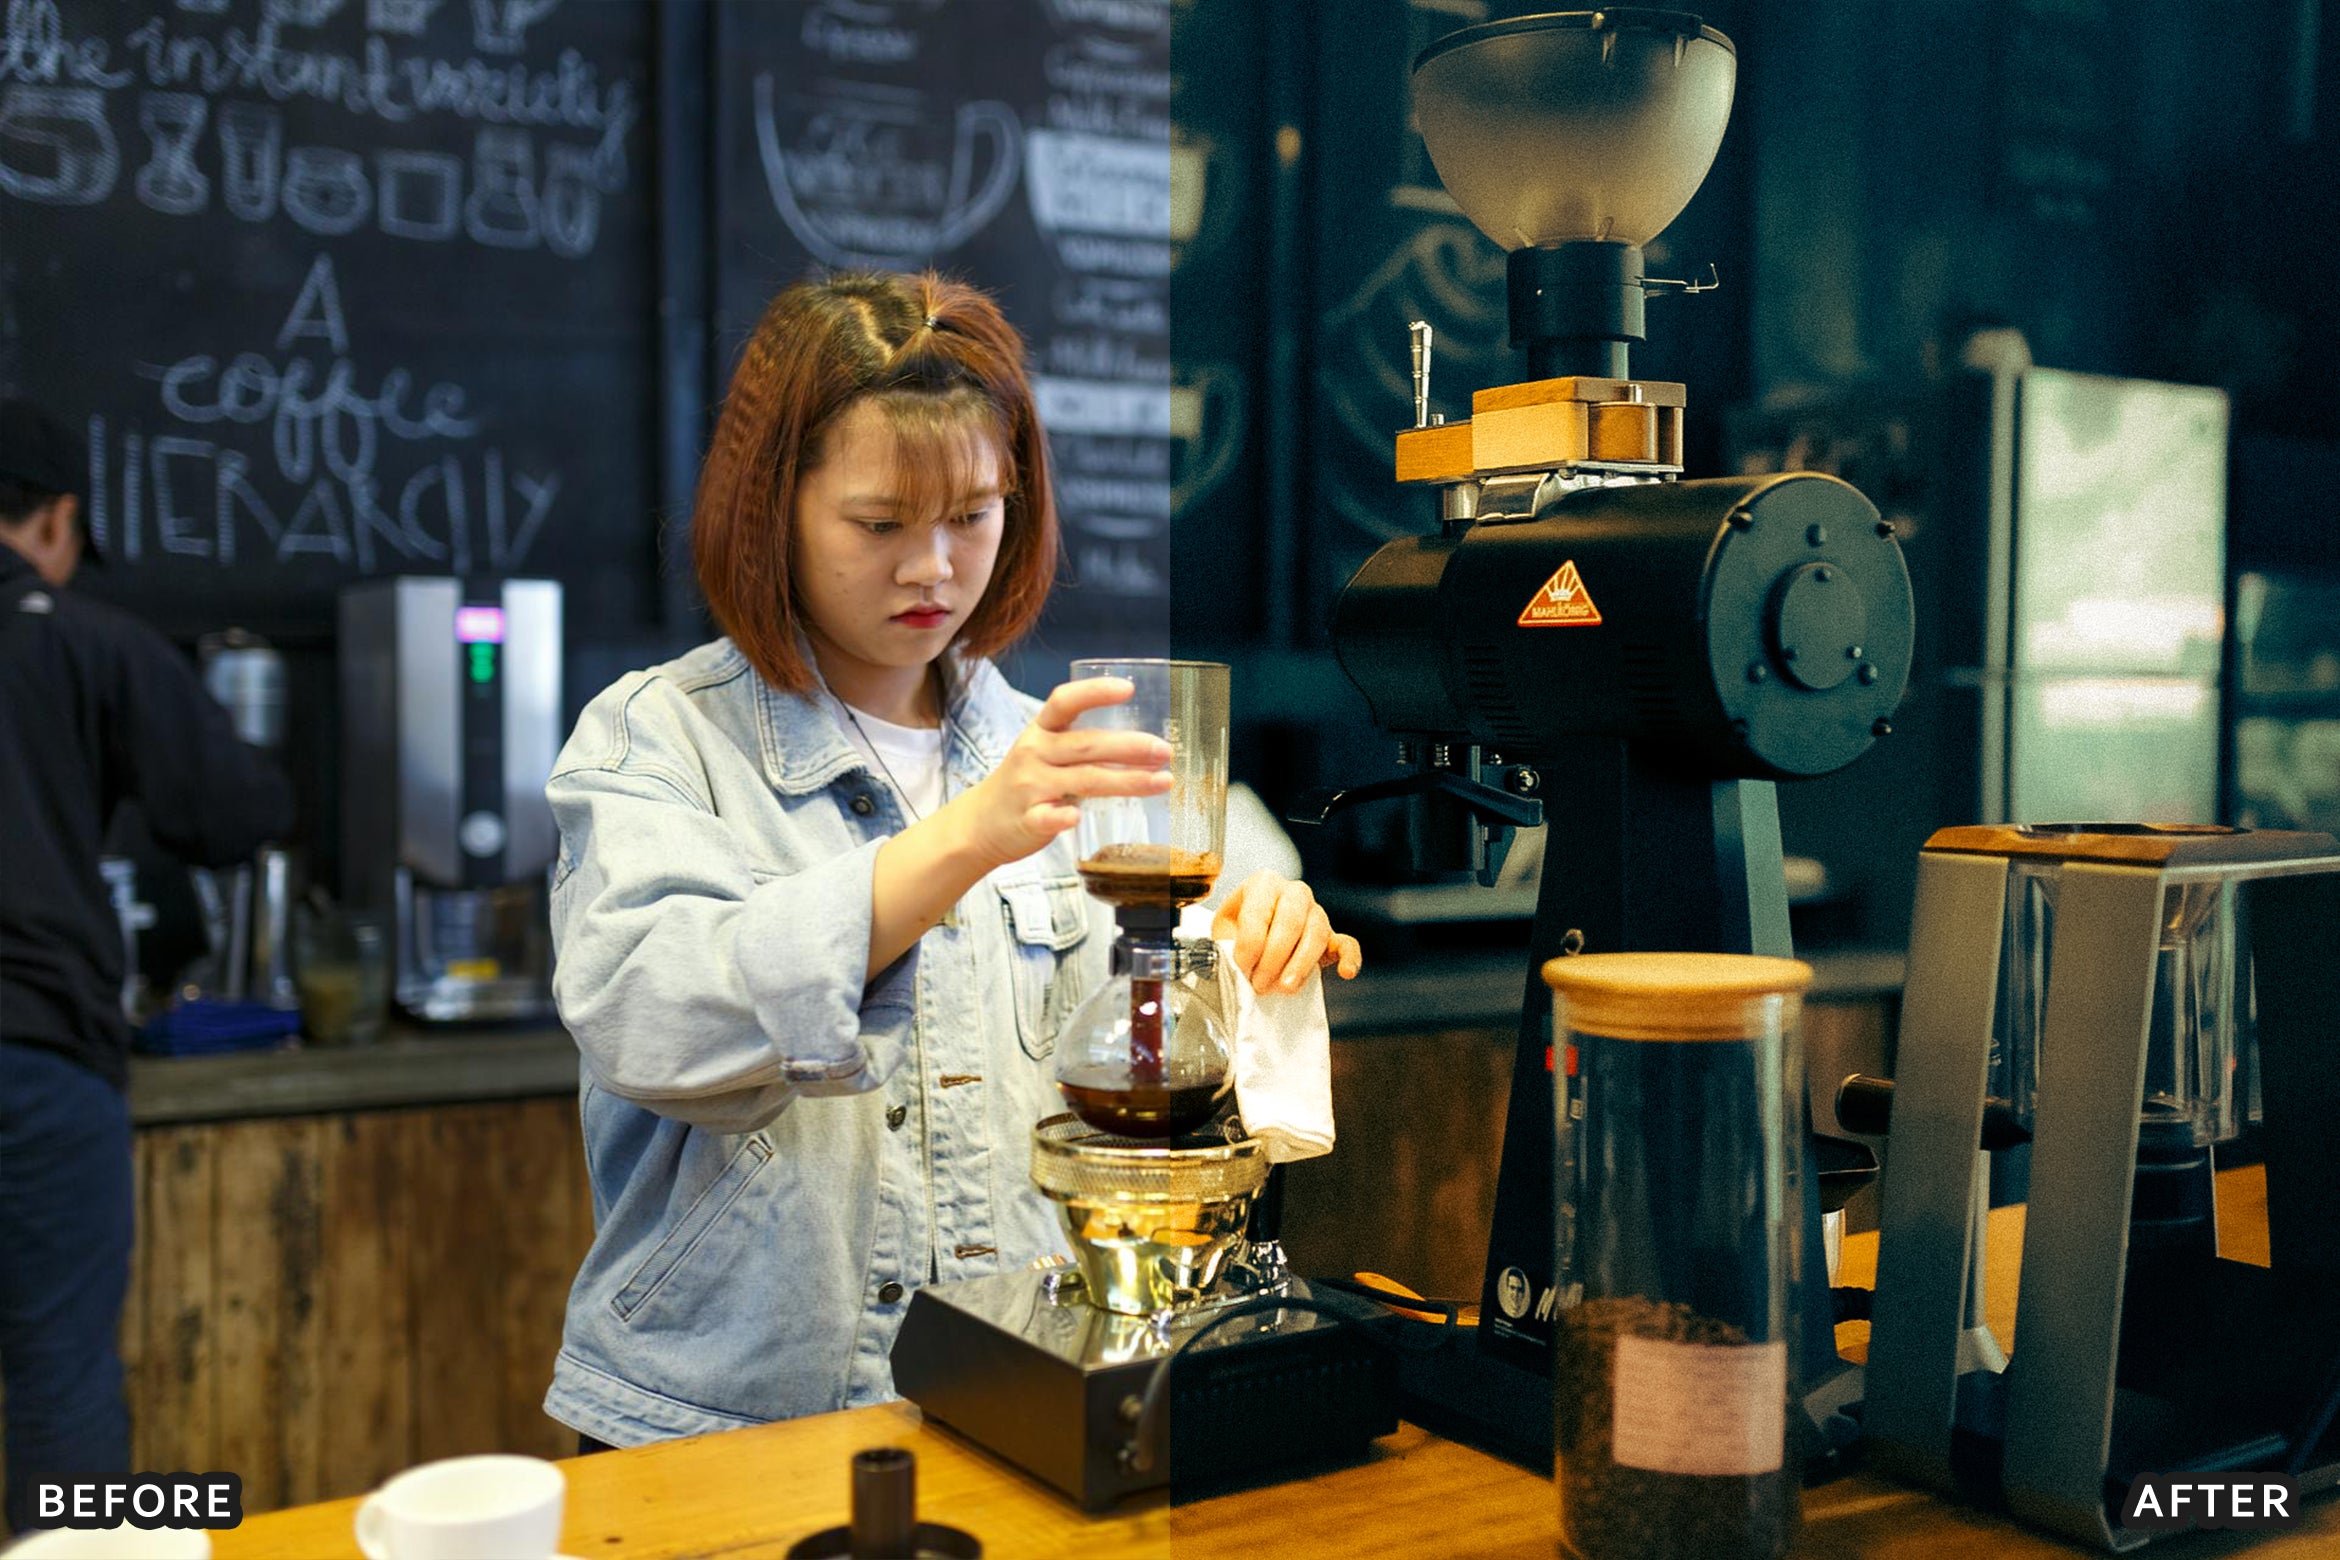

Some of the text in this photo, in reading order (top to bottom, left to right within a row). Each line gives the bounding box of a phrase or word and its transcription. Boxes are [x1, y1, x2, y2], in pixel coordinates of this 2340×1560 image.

[0, 0, 136, 90] the
[275, 252, 350, 354] A
[143, 352, 484, 484] coffee
